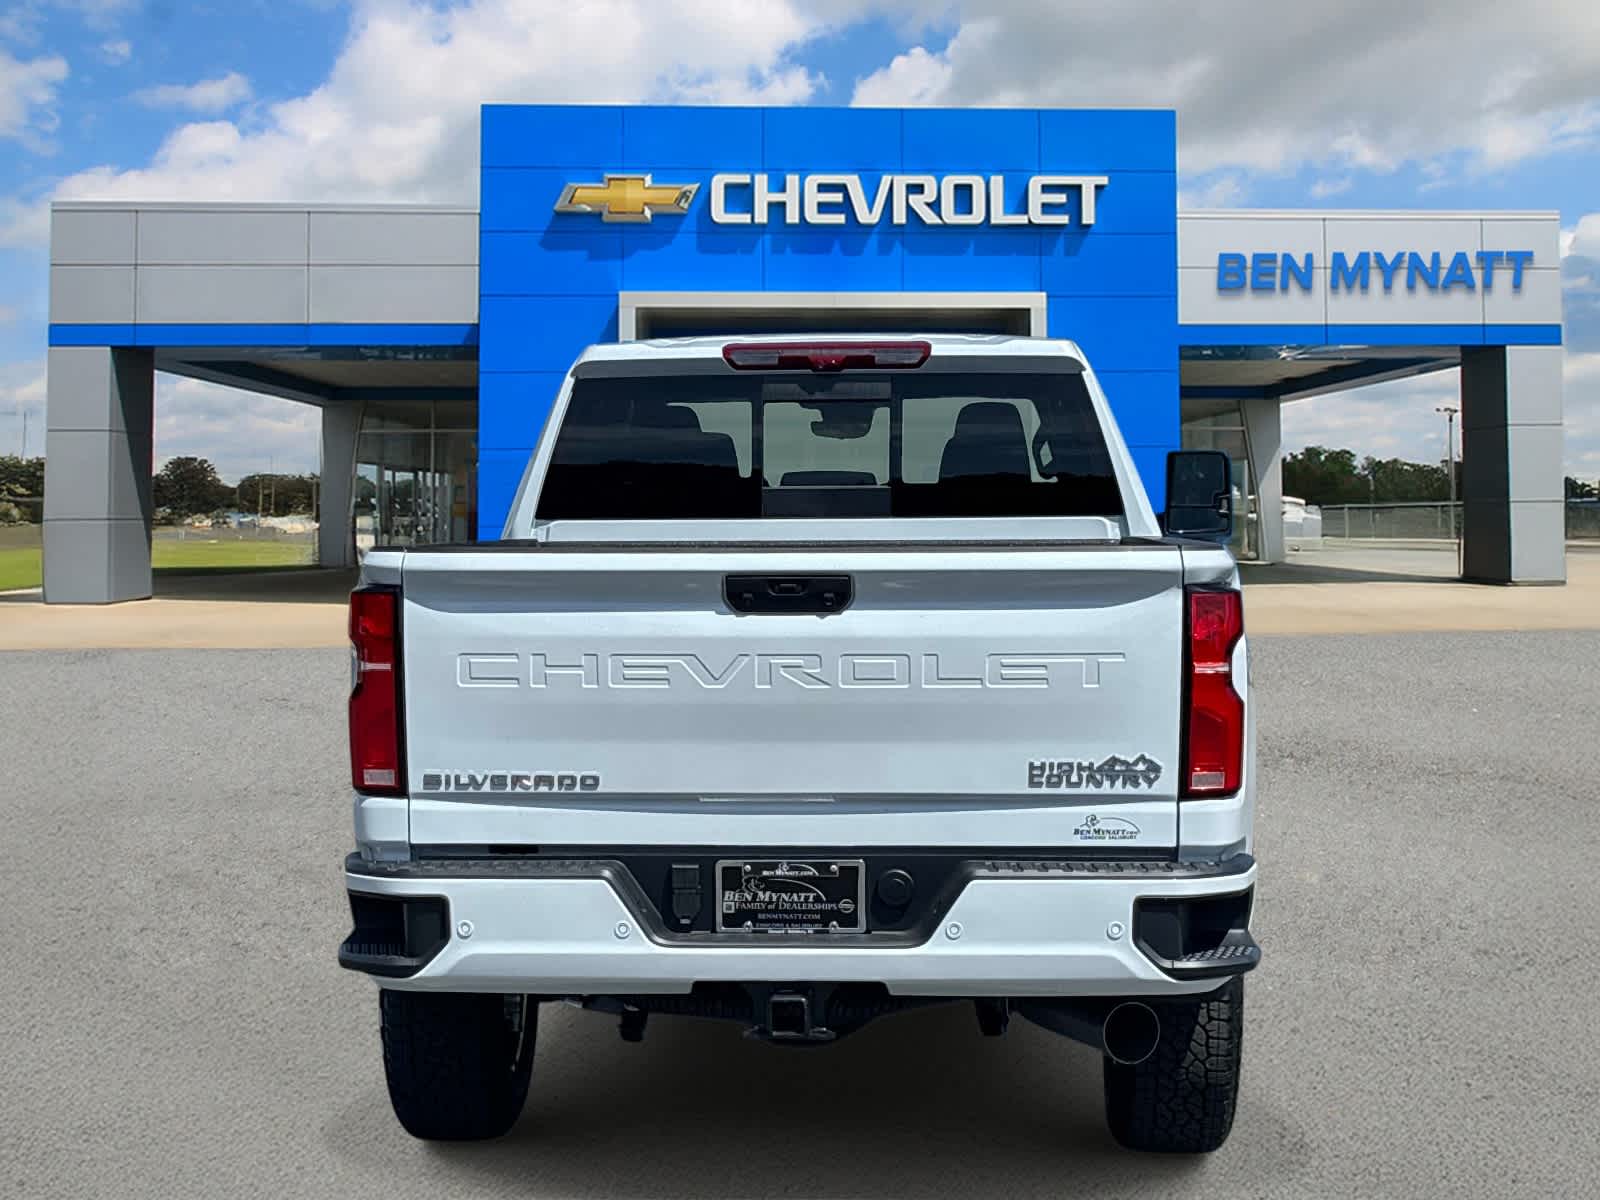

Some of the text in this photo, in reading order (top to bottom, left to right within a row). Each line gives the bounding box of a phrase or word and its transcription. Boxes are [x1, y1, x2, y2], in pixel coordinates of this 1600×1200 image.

[711, 173, 1109, 226] CHEVROLET
[1216, 250, 1534, 290] BEN MYNATT
[456, 652, 1126, 690] CHEVROLET
[422, 774, 600, 791] SILVERADO
[1028, 773, 1160, 789] COUNTRY
[1073, 828, 1091, 836] BEN
[724, 890, 817, 902] BEN MYNATT
[735, 901, 766, 910] FAMILY
[779, 901, 838, 910] DEALERSHIPS
